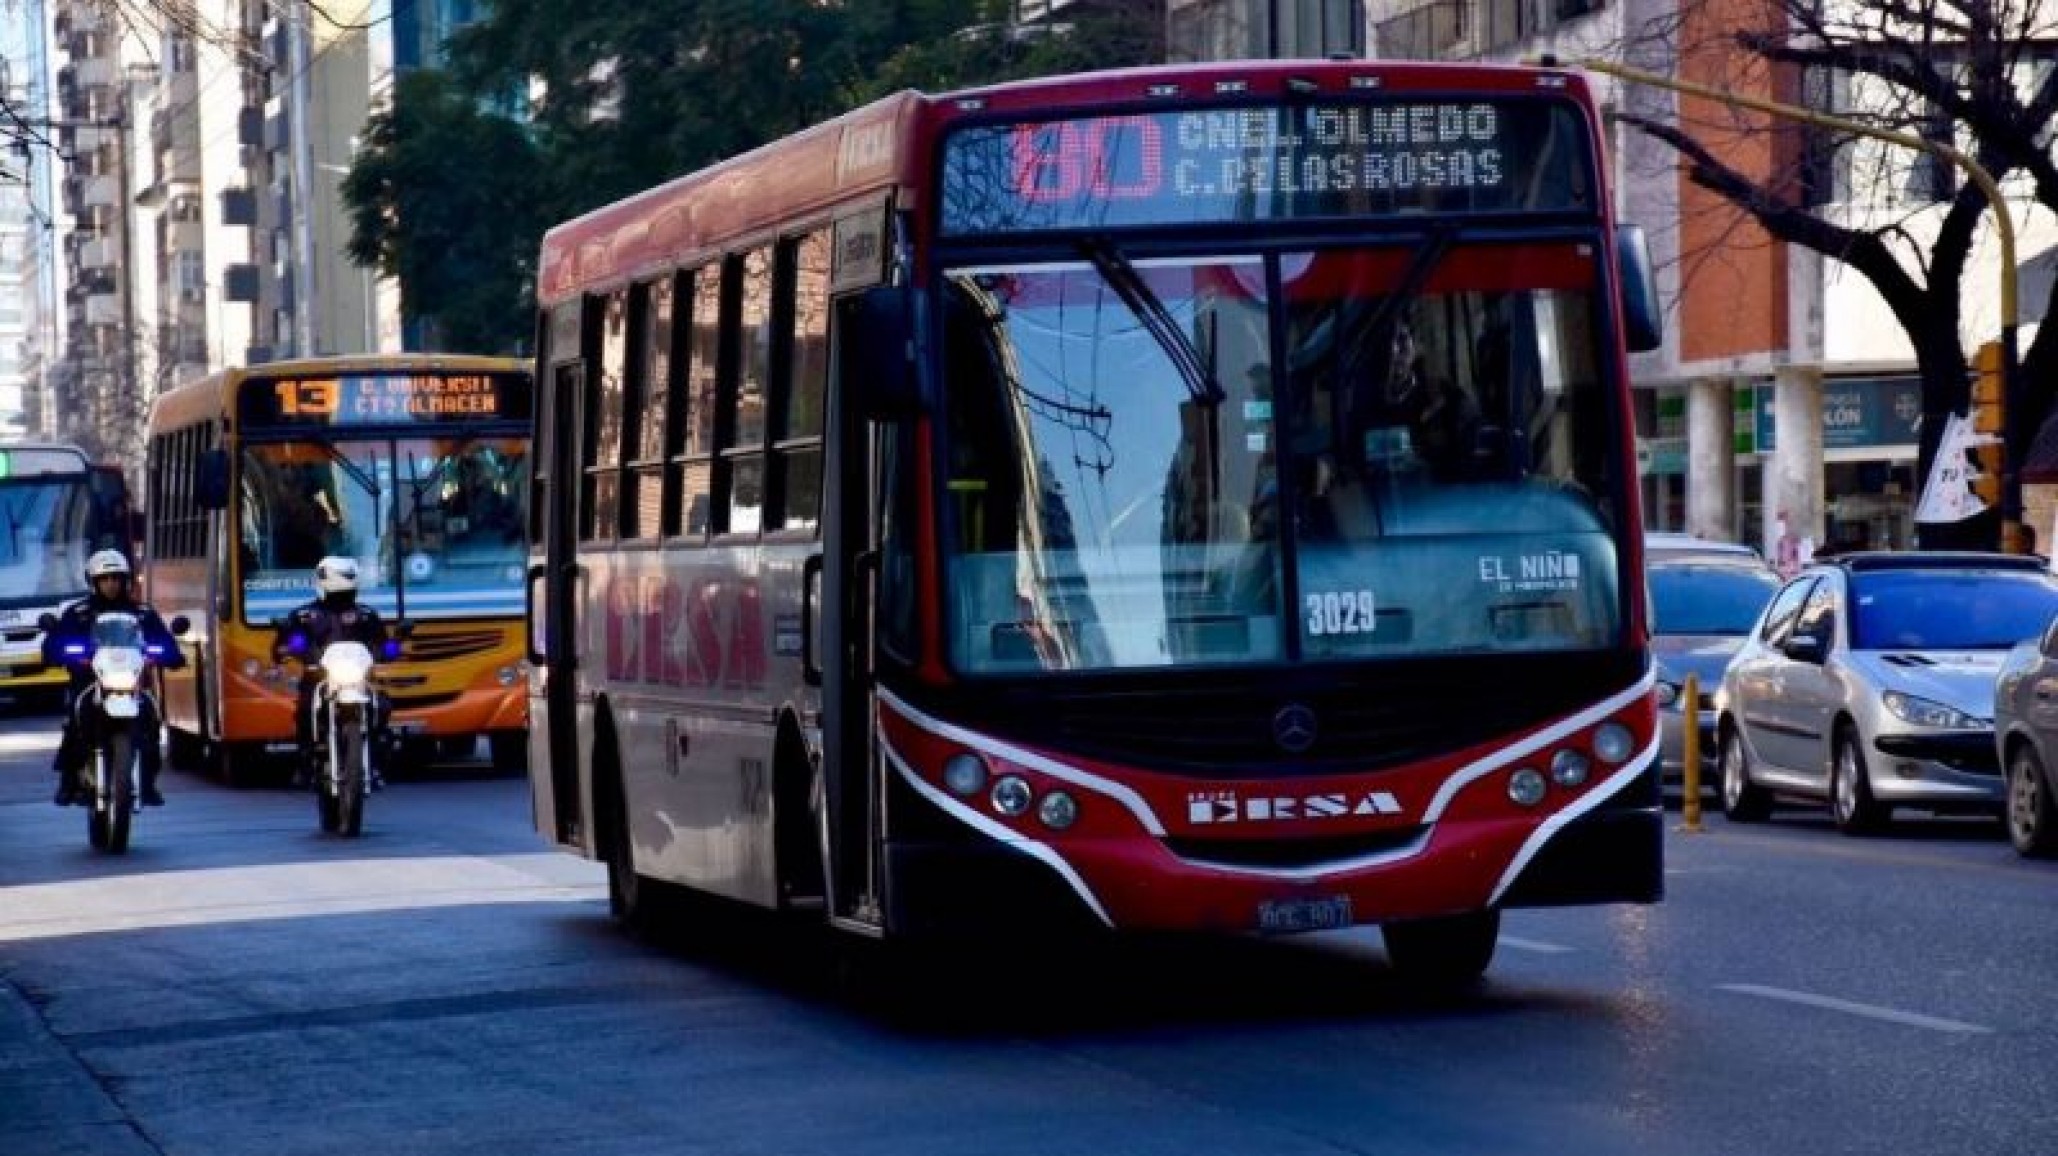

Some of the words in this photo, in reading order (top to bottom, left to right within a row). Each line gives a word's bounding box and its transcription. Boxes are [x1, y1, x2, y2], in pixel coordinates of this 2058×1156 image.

[1315, 104, 1497, 145] OLMEDO
[274, 379, 338, 413] 13
[1480, 555, 1510, 581] EL
[1306, 590, 1376, 636] 3029
